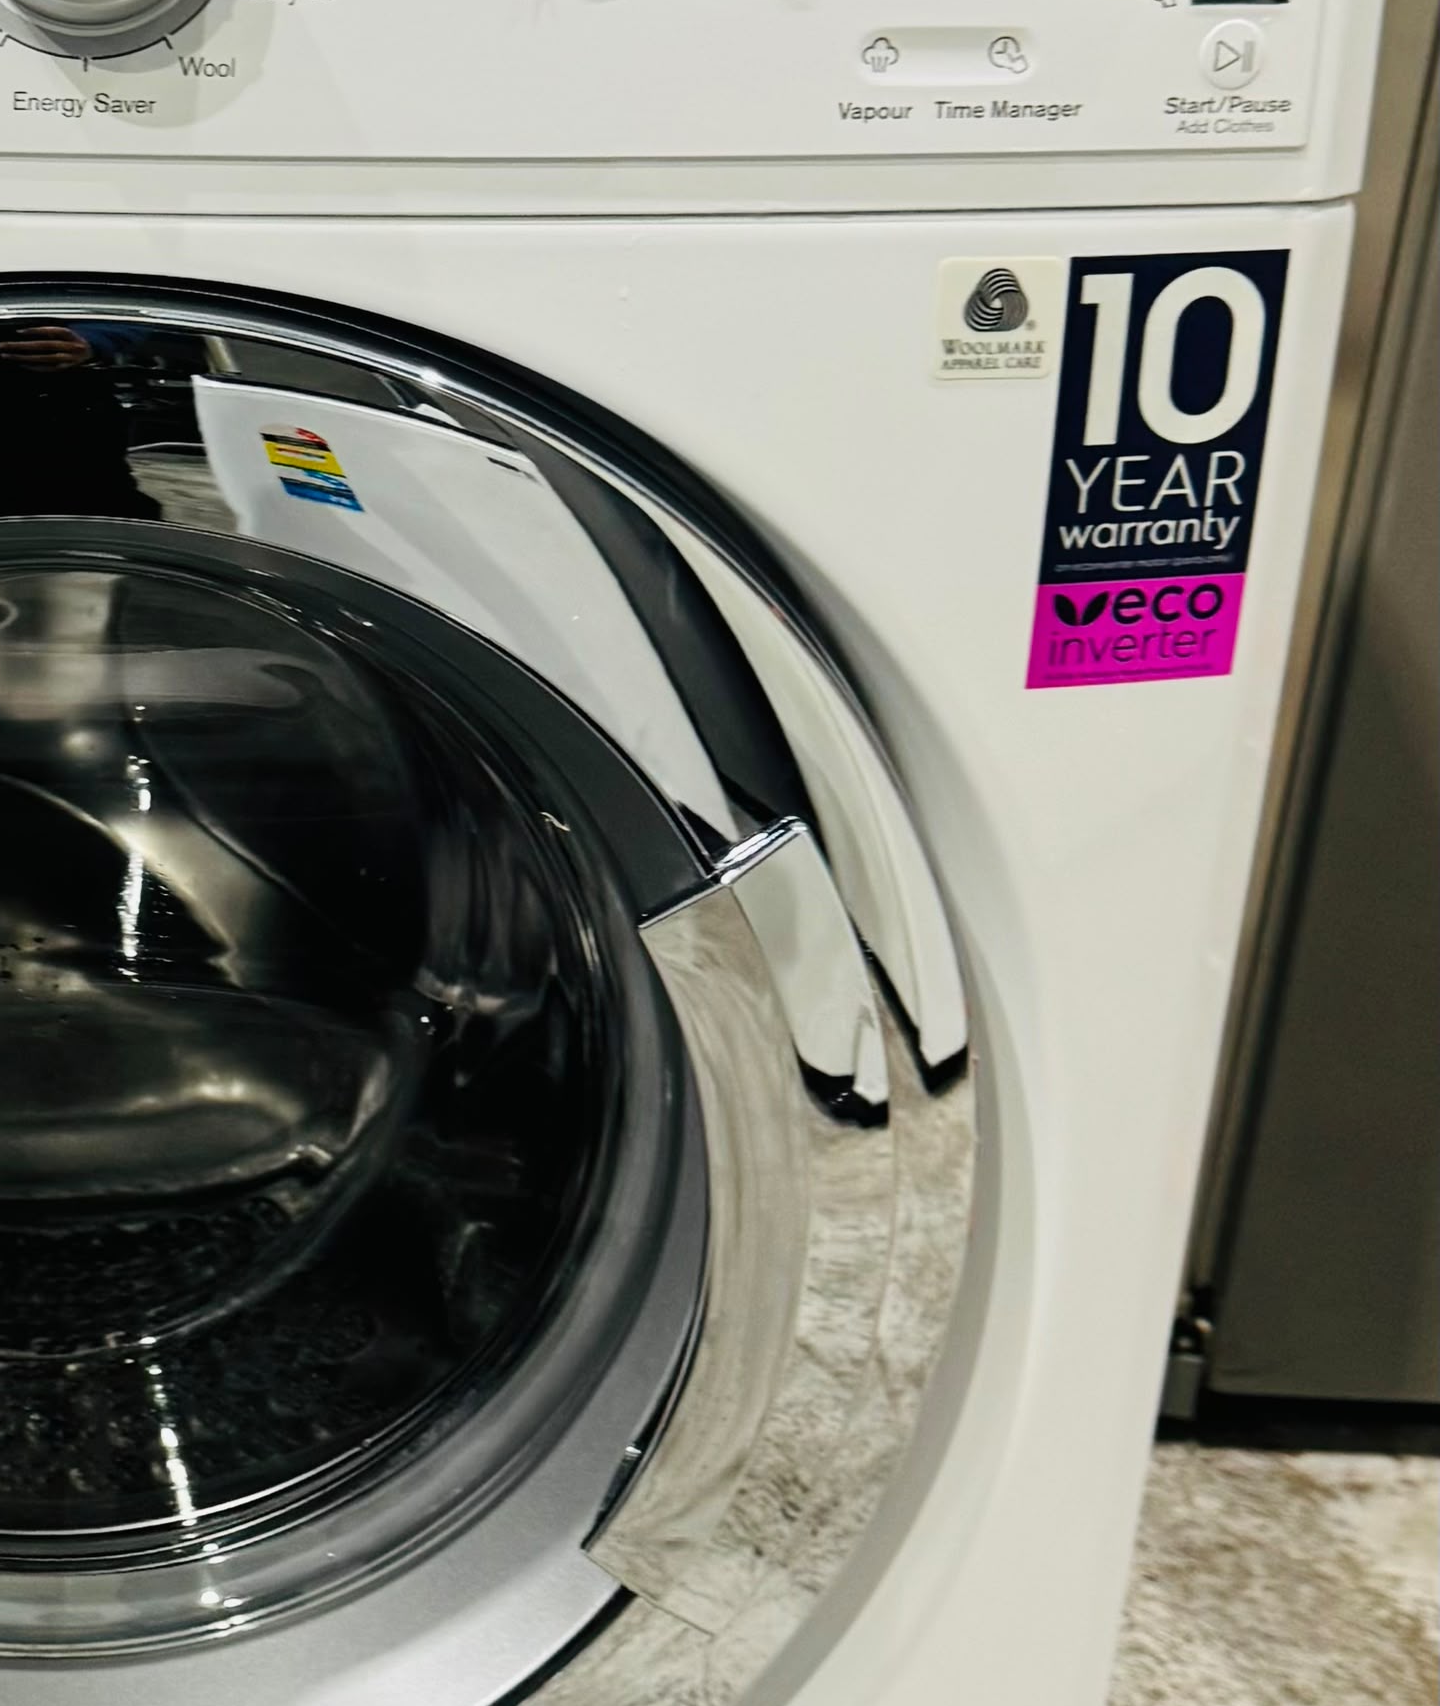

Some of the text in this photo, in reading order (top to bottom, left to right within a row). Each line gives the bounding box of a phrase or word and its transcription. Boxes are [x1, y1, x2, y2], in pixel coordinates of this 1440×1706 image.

[179, 56, 236, 78] Wool
[13, 92, 157, 118] Energy Saver
[838, 101, 914, 124] Vapour
[934, 100, 1083, 122] Time Manager
[1163, 96, 1292, 115] Start/Pause
[1175, 119, 1275, 135] Add Clothes
[941, 338, 1046, 356] WOOLMARK
[1080, 266, 1265, 446] 10
[1065, 450, 1247, 515] YEAR
[1059, 509, 1241, 550] warranty
[1111, 583, 1224, 625] eco
[1048, 626, 1218, 667] inverter
